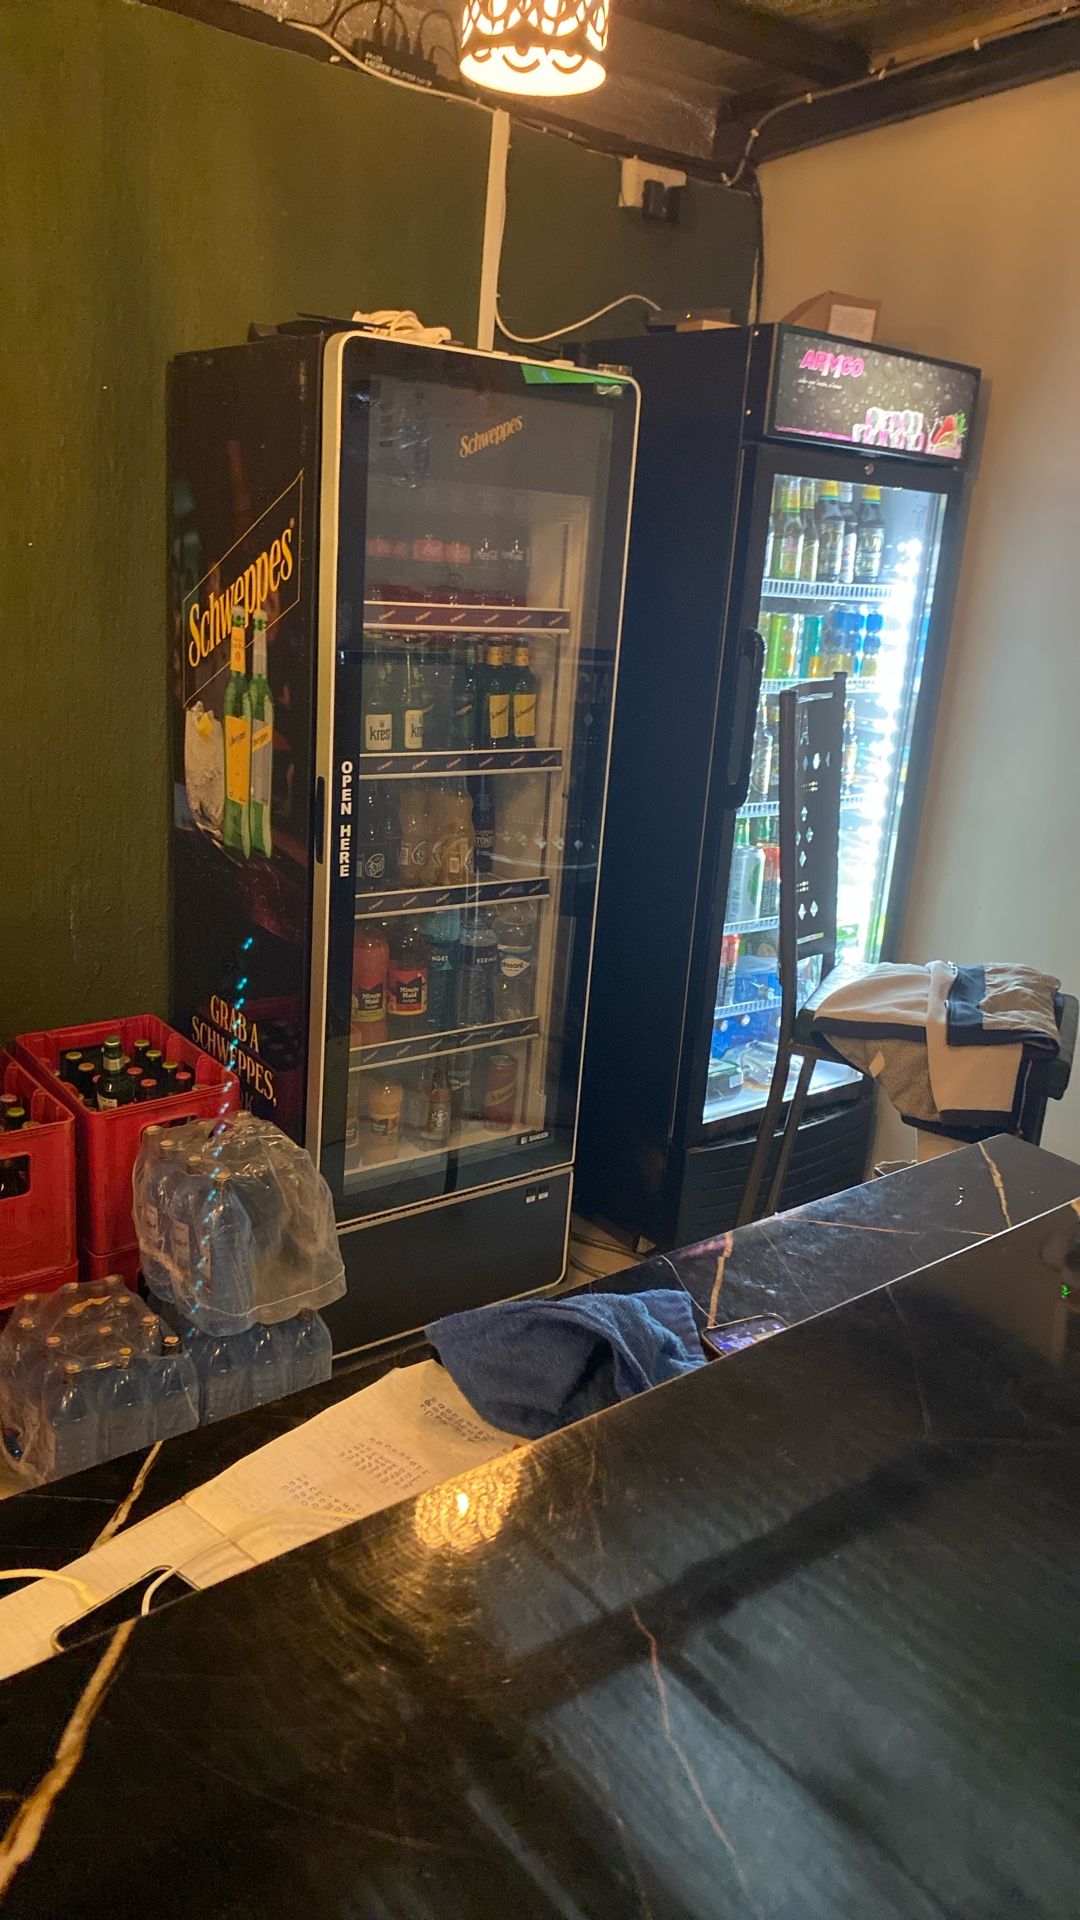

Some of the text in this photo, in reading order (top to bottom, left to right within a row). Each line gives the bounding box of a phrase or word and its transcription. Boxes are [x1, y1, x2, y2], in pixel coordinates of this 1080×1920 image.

[800, 349, 865, 378] ARMCO
[460, 415, 523, 458] Schweppes
[188, 528, 293, 667] Schweppes
[339, 761, 353, 878] OPEN HERE
[210, 995, 259, 1053] GRAB A
